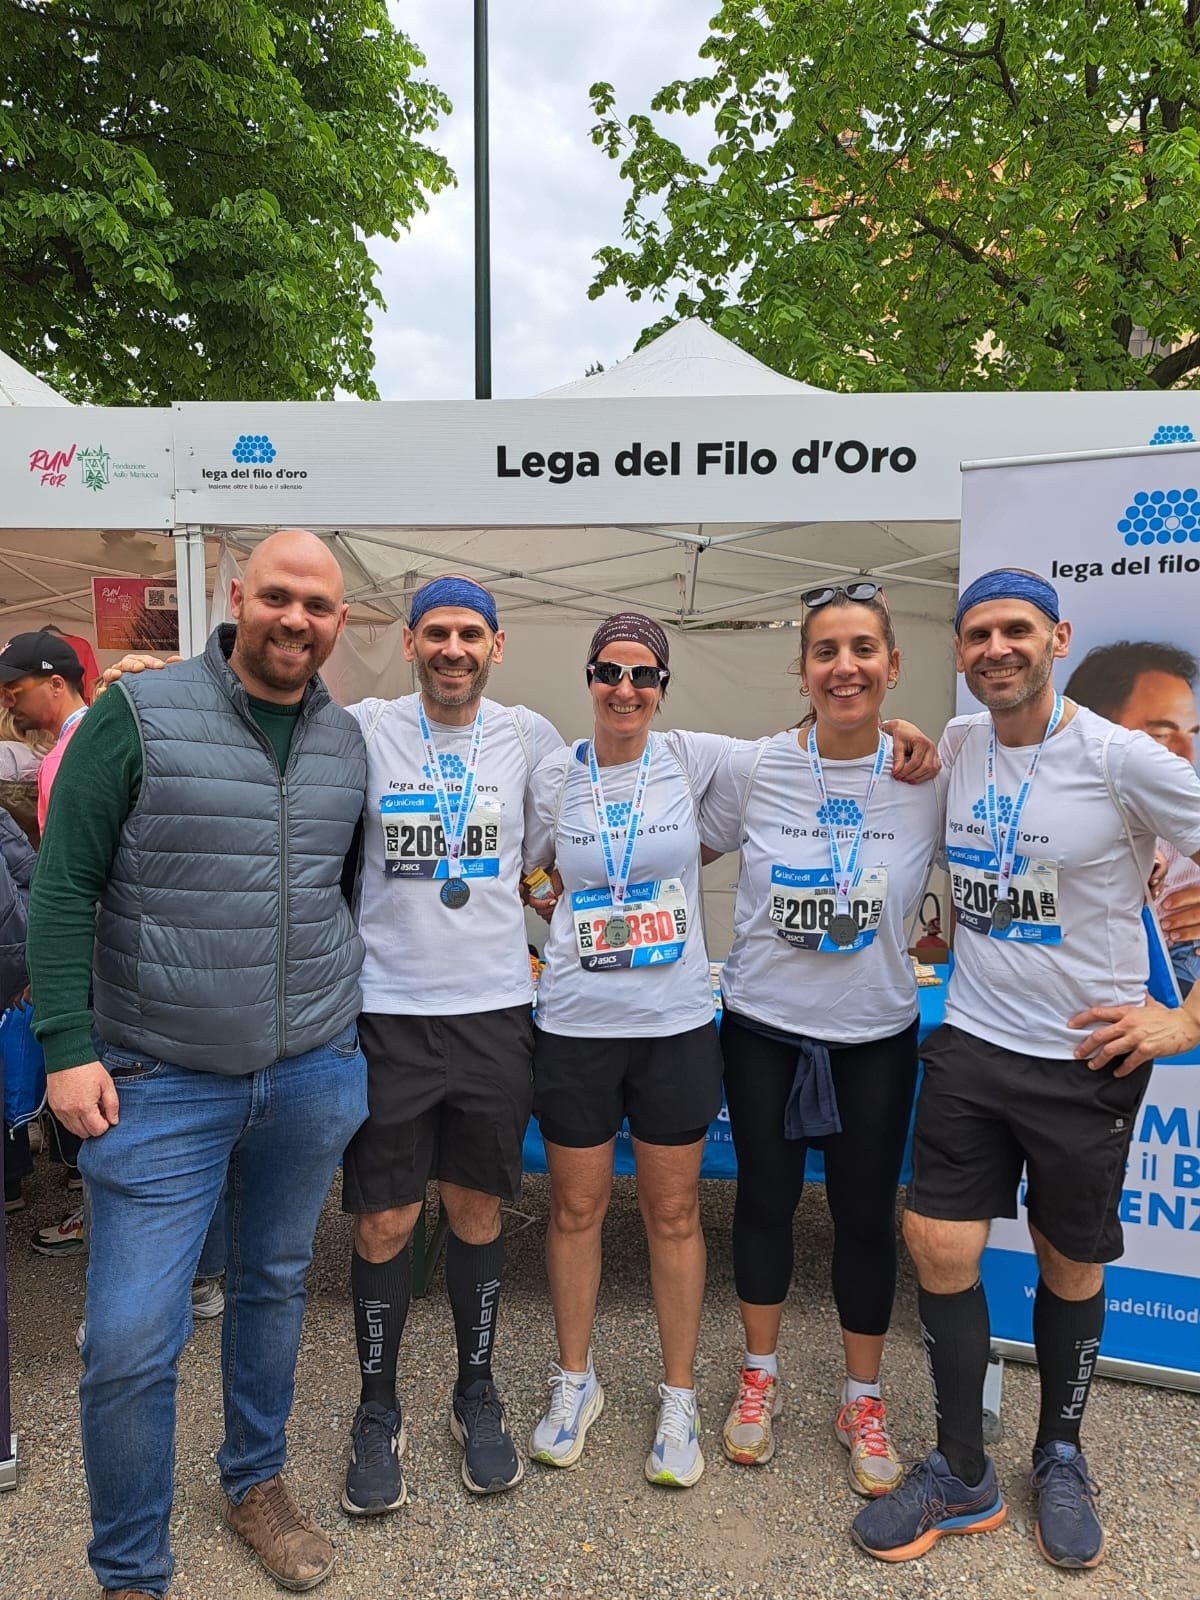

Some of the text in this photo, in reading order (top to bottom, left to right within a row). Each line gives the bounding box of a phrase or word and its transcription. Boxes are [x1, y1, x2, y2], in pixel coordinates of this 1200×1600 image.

[29, 443, 77, 473] RUN
[497, 439, 917, 484] Lega del Filo d'Oro
[112, 462, 147, 470] Fondazione
[40, 472, 67, 488] FOR
[202, 468, 307, 481] lega del filo d'oro
[1051, 555, 1200, 583] lega del filo
[388, 780, 414, 792] lega
[418, 781, 434, 792] de
[393, 798, 424, 808] UniCredit
[572, 834, 596, 846] lega
[648, 823, 679, 835] d'oro
[781, 826, 807, 838] lega
[862, 830, 895, 840] d'oro
[966, 823, 985, 835] del
[400, 825, 483, 857] 208B
[400, 863, 420, 871] asics
[782, 871, 810, 882] UniCredit
[583, 892, 610, 903] UniCredi
[785, 898, 868, 931] 208C
[593, 911, 675, 951] 283D
[598, 955, 617, 965] asics
[1142, 1152, 1157, 1181] il
